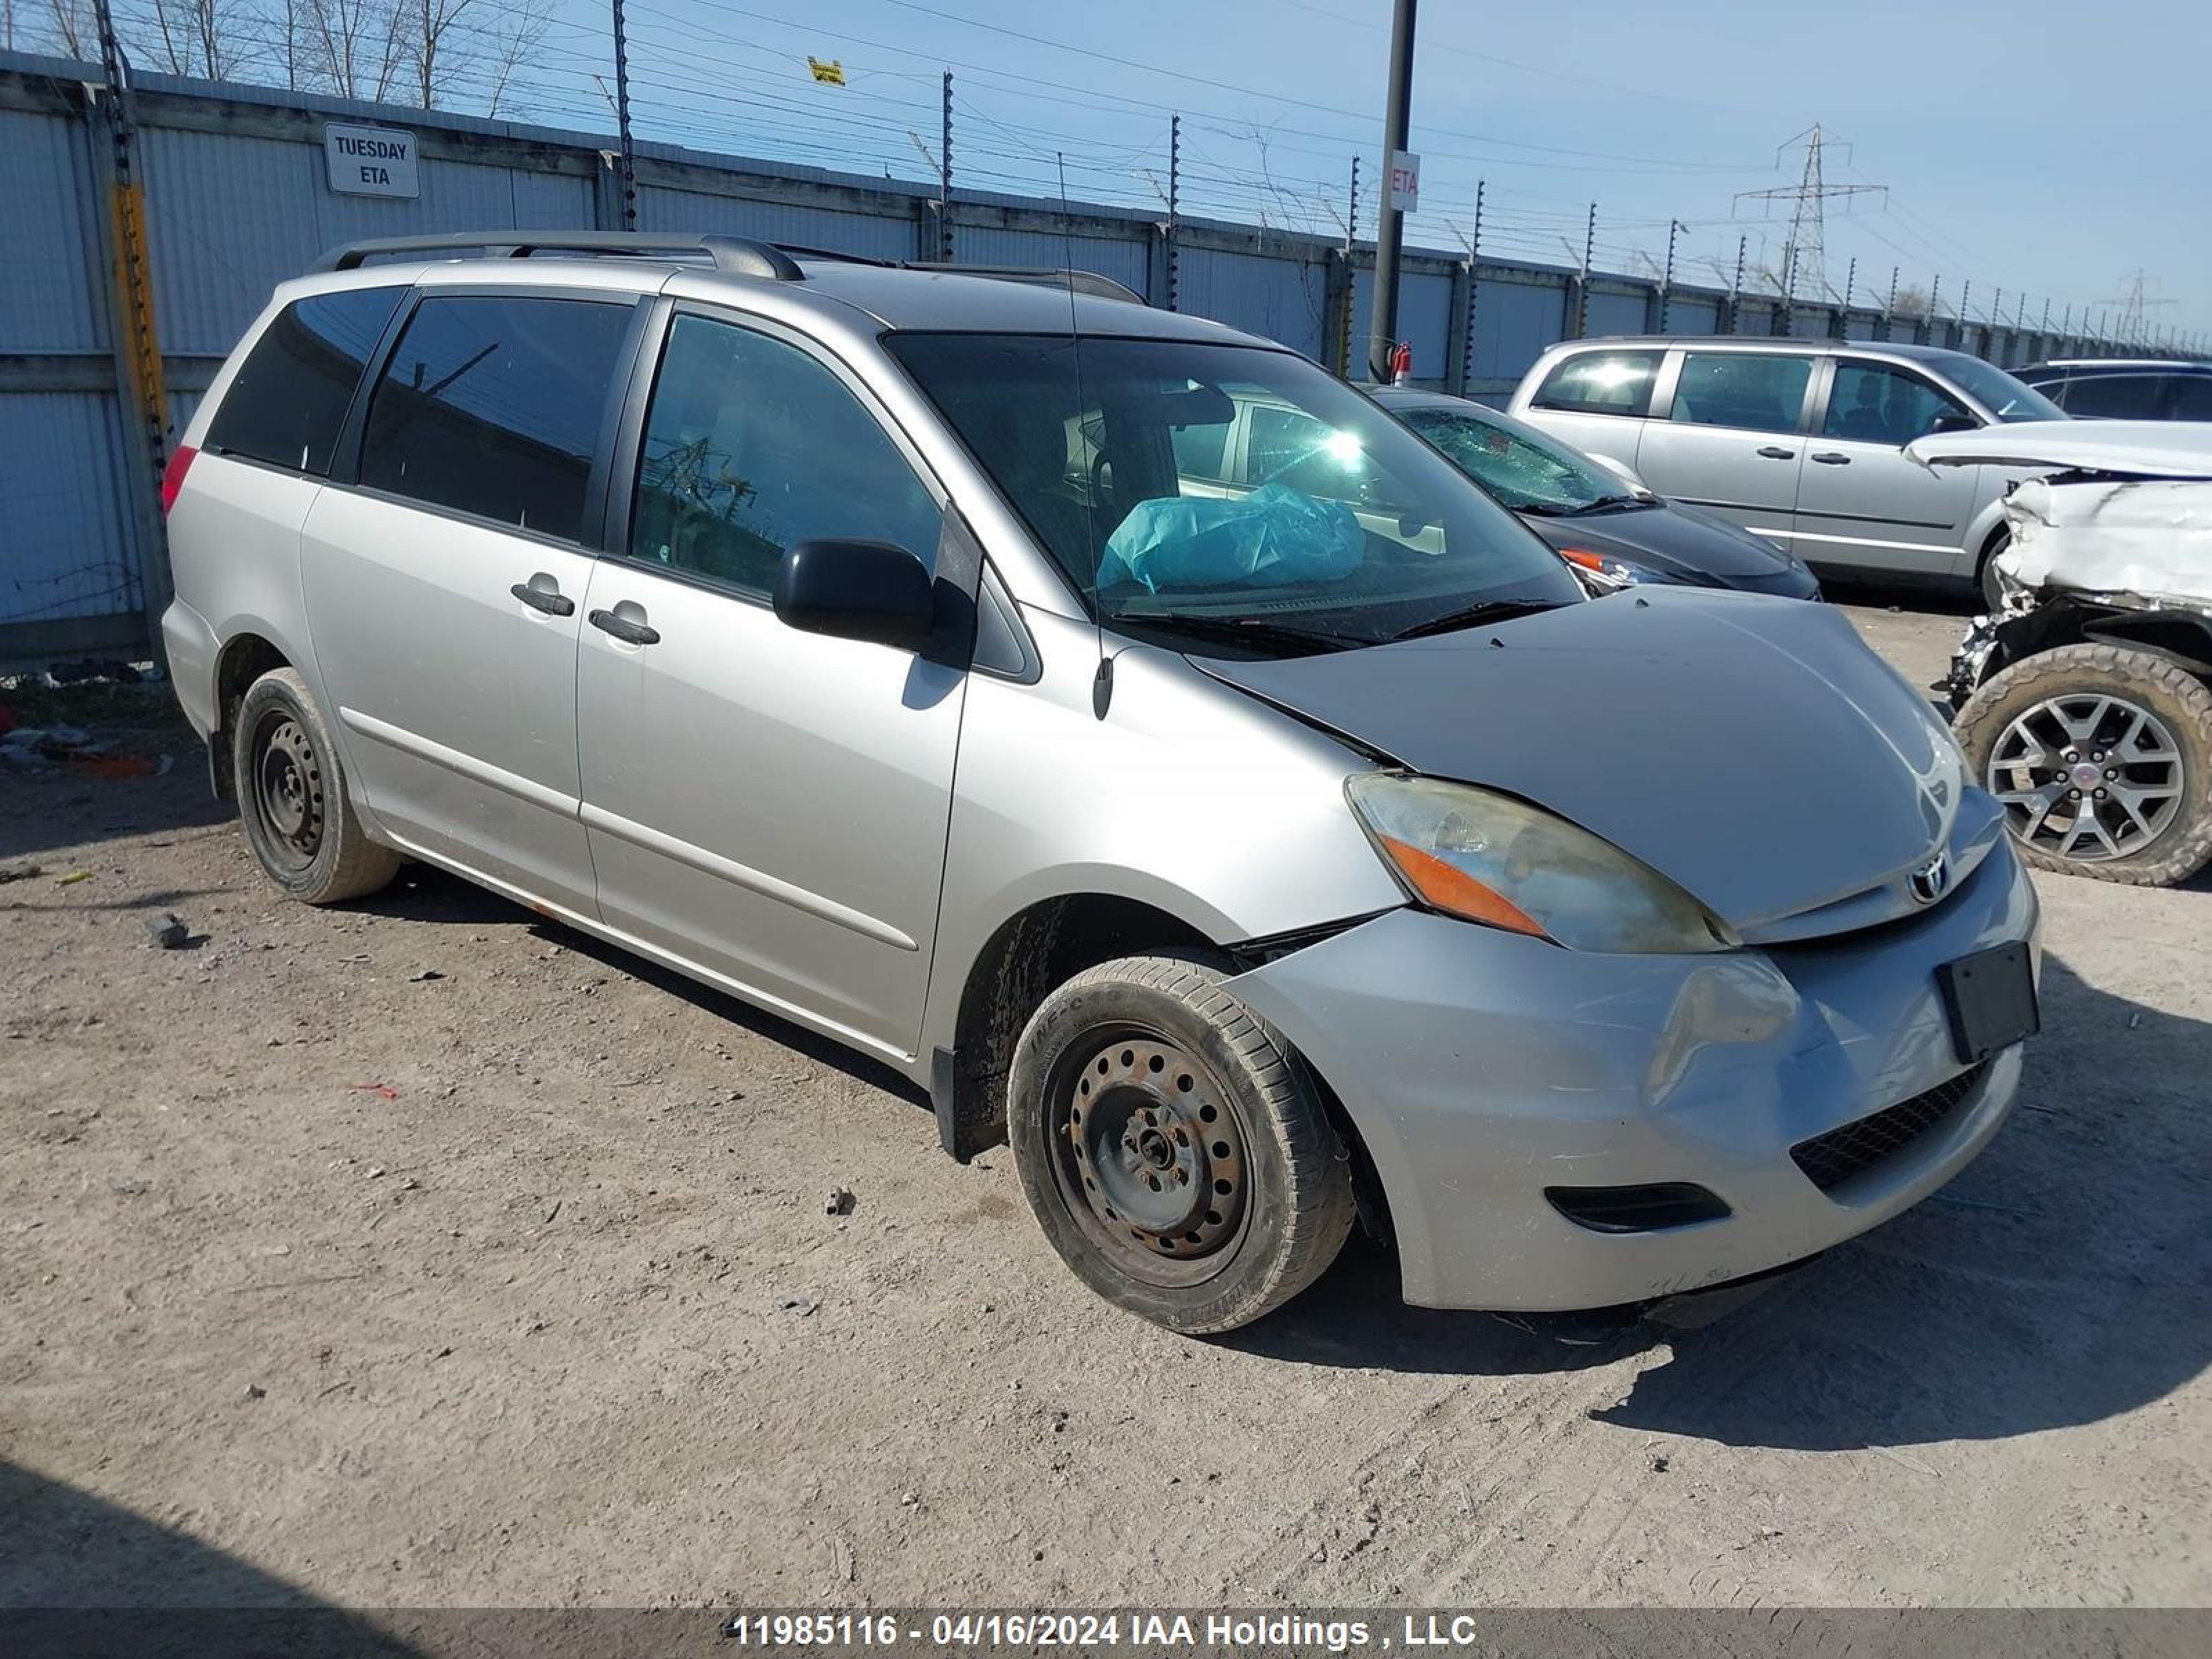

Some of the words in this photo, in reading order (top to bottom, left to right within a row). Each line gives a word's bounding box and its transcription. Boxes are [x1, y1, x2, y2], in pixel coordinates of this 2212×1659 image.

[335, 136, 406, 160] TUESDAY
[360, 166, 391, 185] ETA
[1393, 169, 1416, 194] ETA
